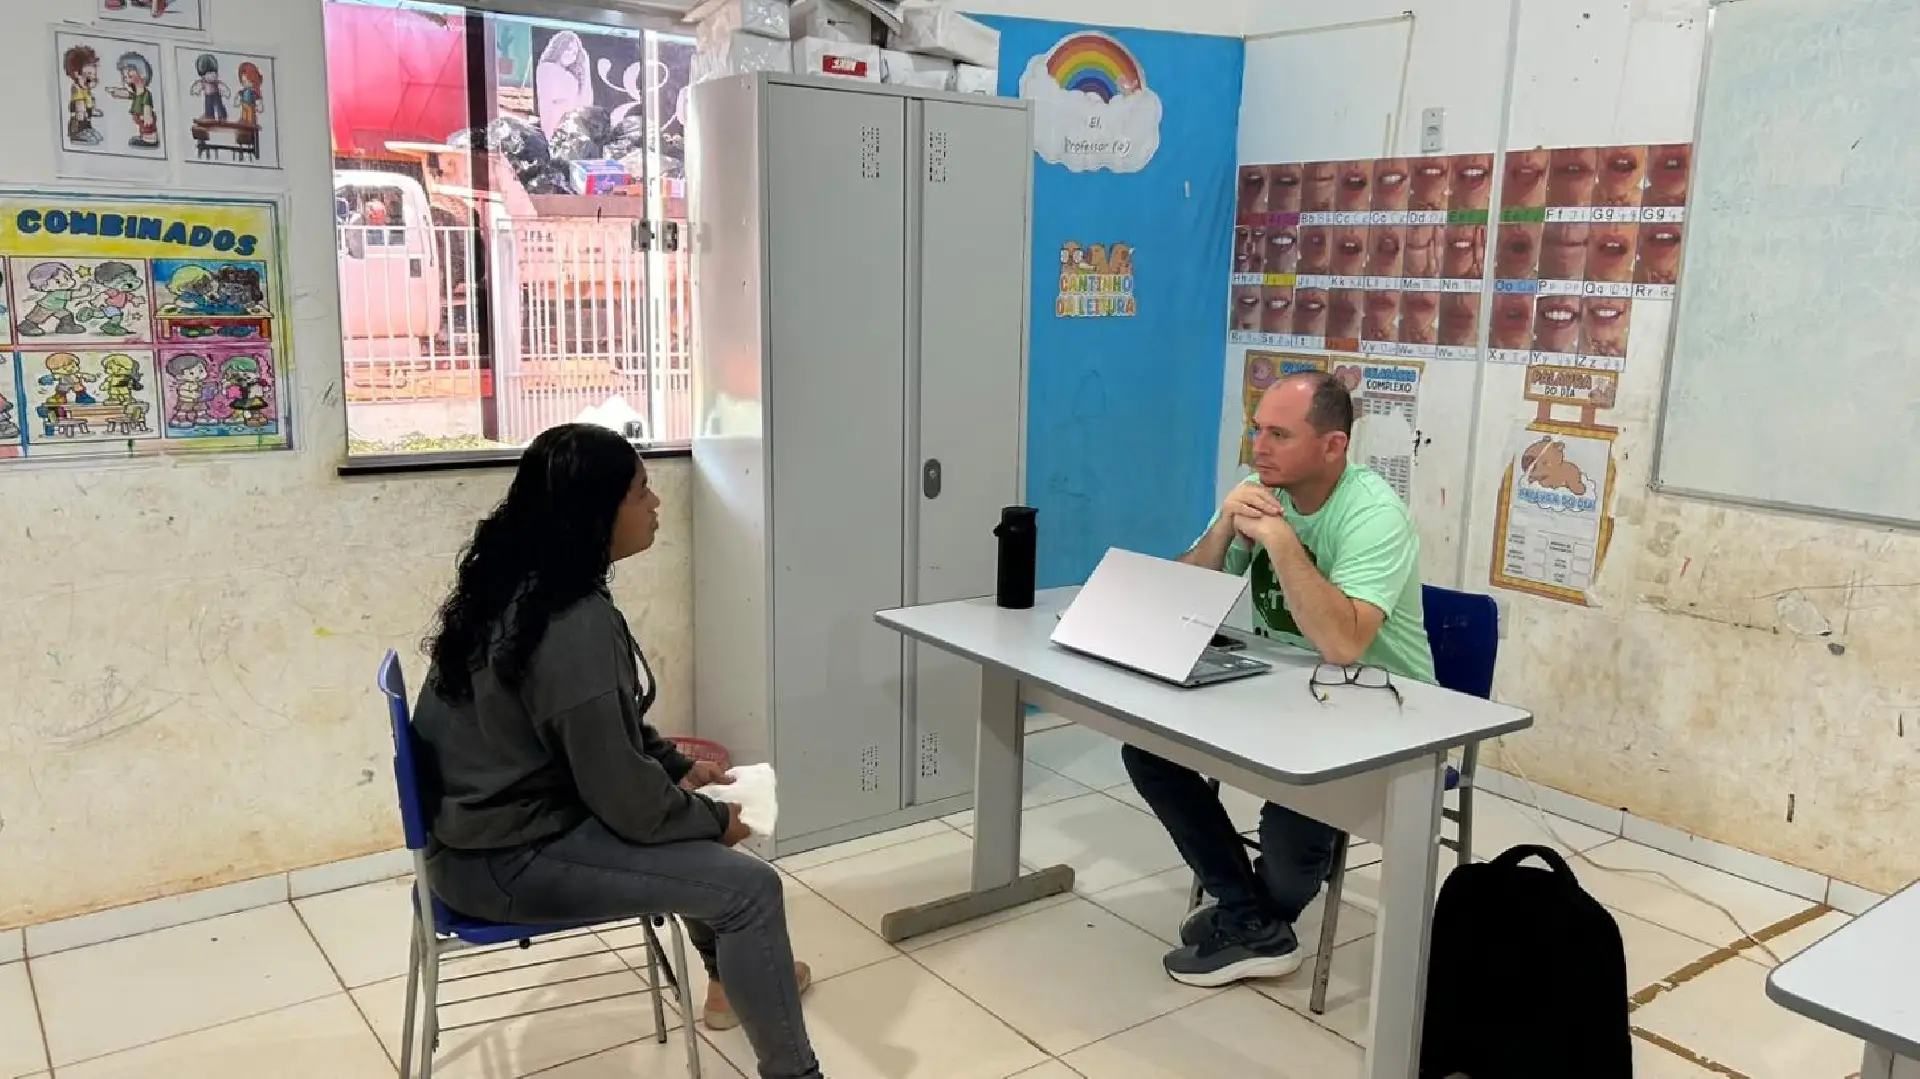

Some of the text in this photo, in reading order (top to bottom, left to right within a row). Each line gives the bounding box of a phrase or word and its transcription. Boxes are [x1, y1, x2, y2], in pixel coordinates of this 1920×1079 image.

[17, 209, 258, 256] COMBINADOS
[1060, 274, 1134, 293] CANTINHO
[1079, 297, 1135, 316] LEITURA
[1366, 380, 1412, 393] COMPLEXO
